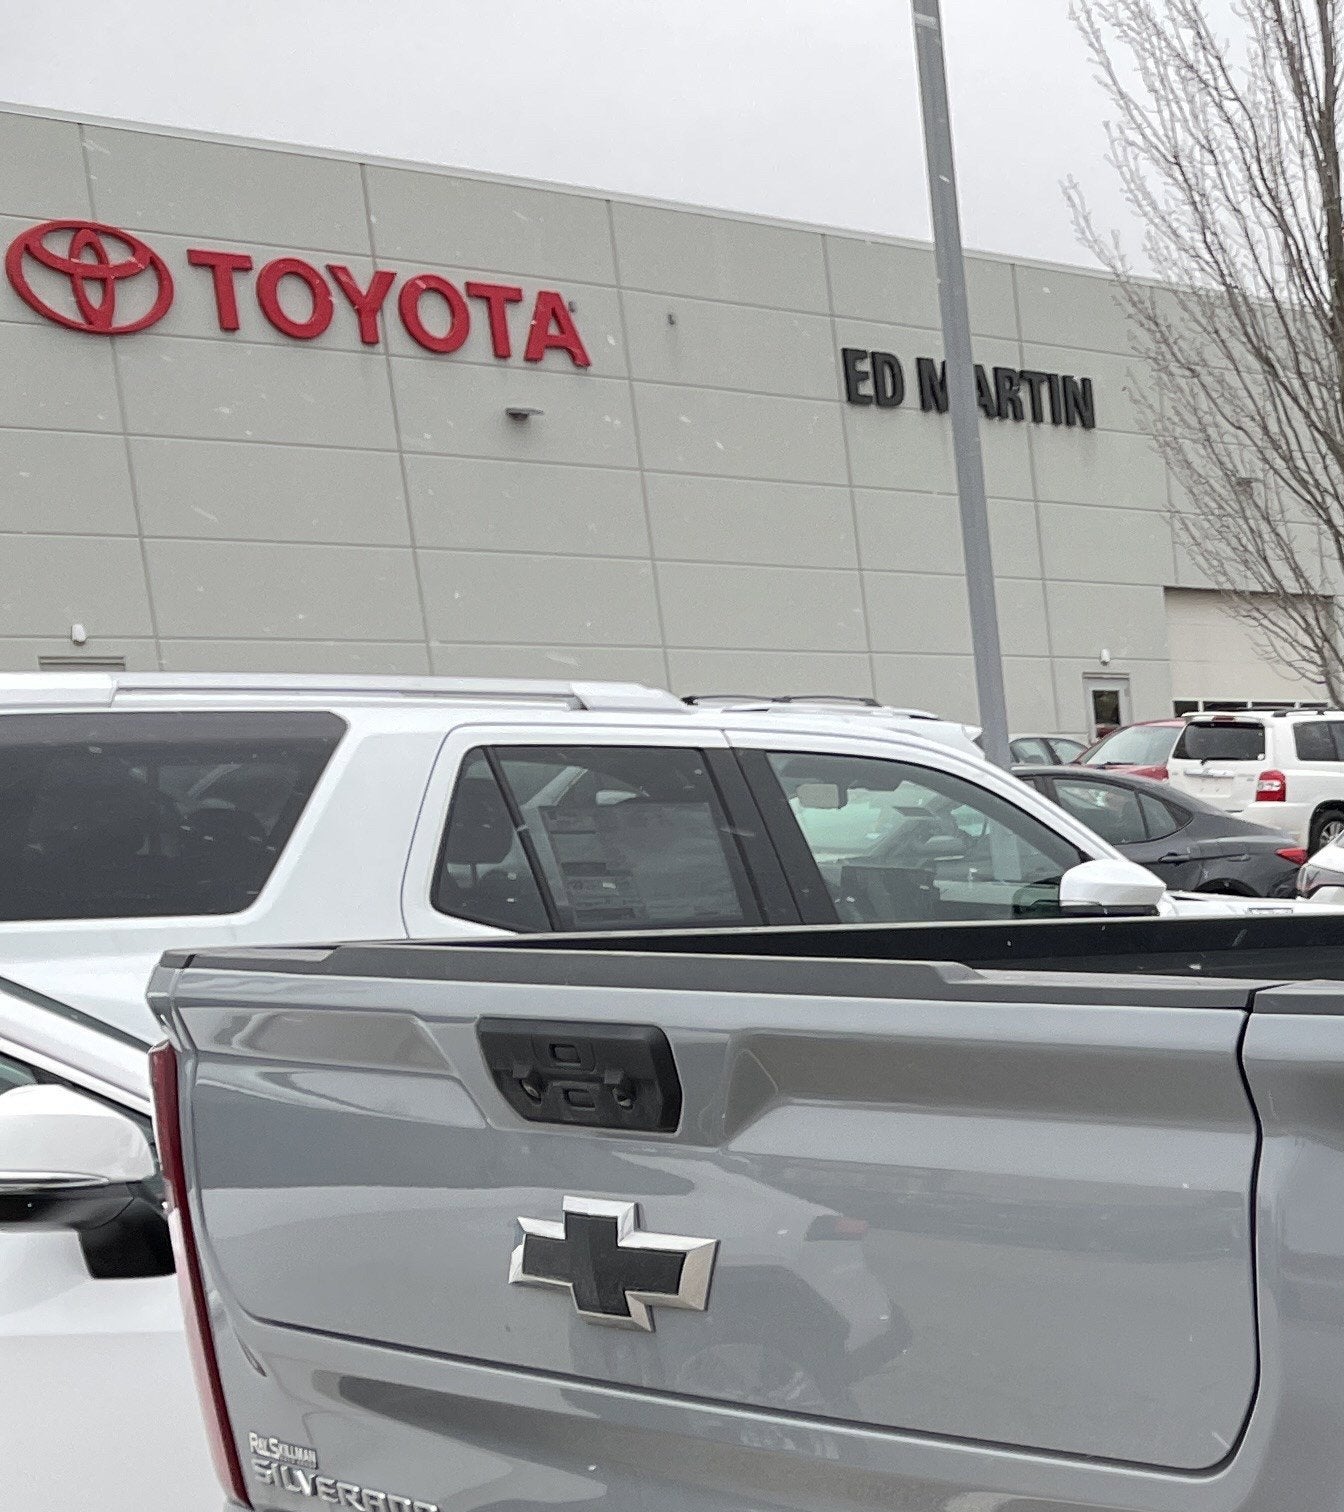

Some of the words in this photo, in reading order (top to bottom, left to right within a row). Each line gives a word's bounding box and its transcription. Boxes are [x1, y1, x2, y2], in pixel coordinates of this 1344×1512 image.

[186, 249, 591, 369] TOYOTA
[841, 347, 905, 407] ED
[916, 356, 1096, 430] MARTIN
